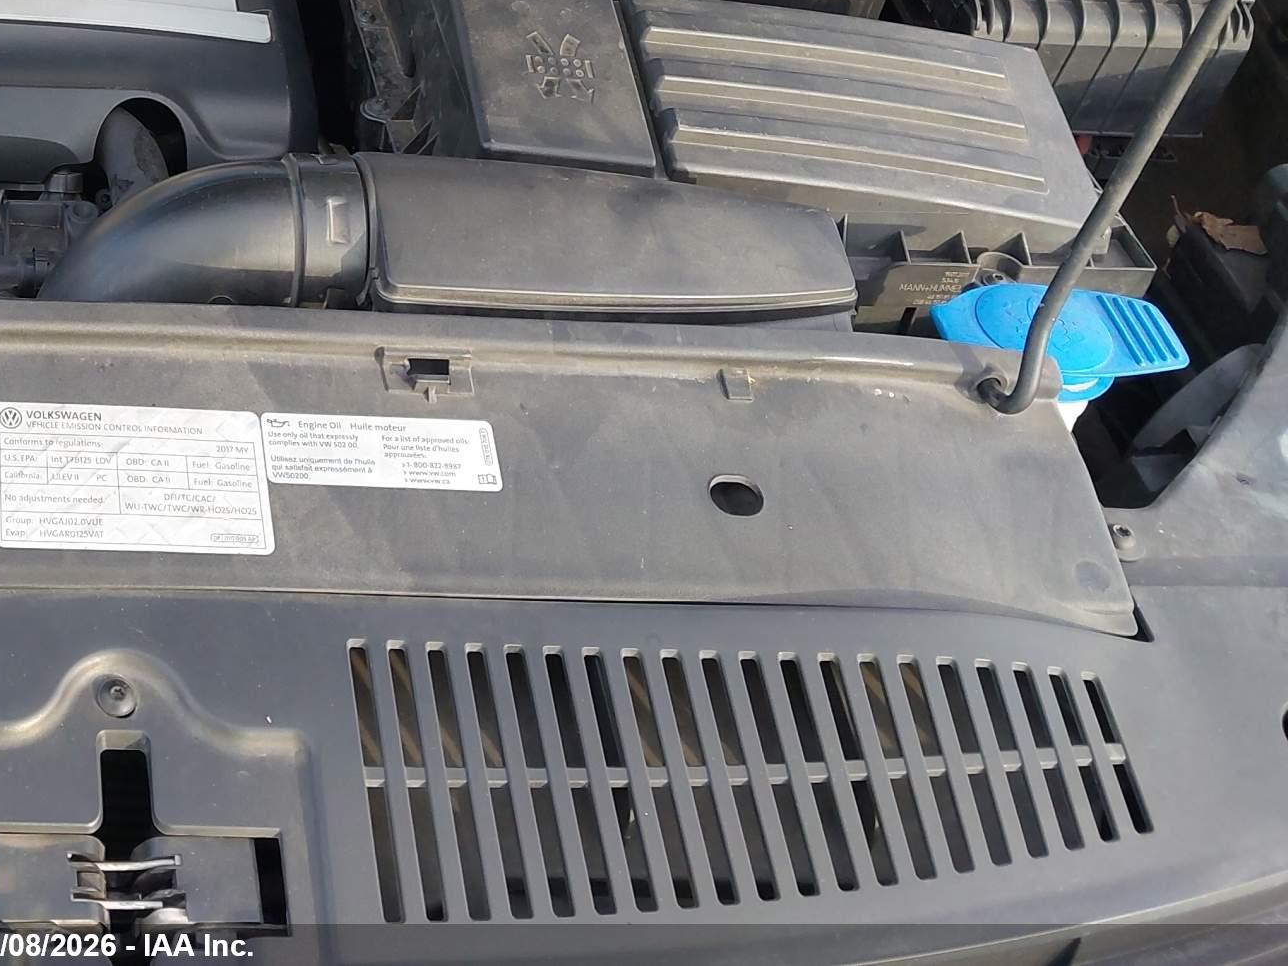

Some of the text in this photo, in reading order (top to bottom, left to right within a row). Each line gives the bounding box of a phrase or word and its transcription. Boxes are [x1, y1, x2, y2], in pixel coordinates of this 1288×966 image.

[26, 411, 101, 421] VOLKSWAGEN
[26, 421, 202, 434] VEHICLE EMISSION CONTROL INFORMATION
[298, 421, 327, 431] Engine
[375, 424, 406, 432] moteur
[4, 438, 43, 446] Conforms
[269, 439, 300, 447] complies
[422, 437, 454, 445] approved
[235, 446, 248, 454] MY
[271, 454, 297, 462] Utilisez
[299, 456, 342, 464] uniquement
[214, 462, 250, 471] Gasoline
[216, 479, 252, 488] Gasoline
[4, 494, 16, 502] No
[19, 494, 70, 504] adjustments
